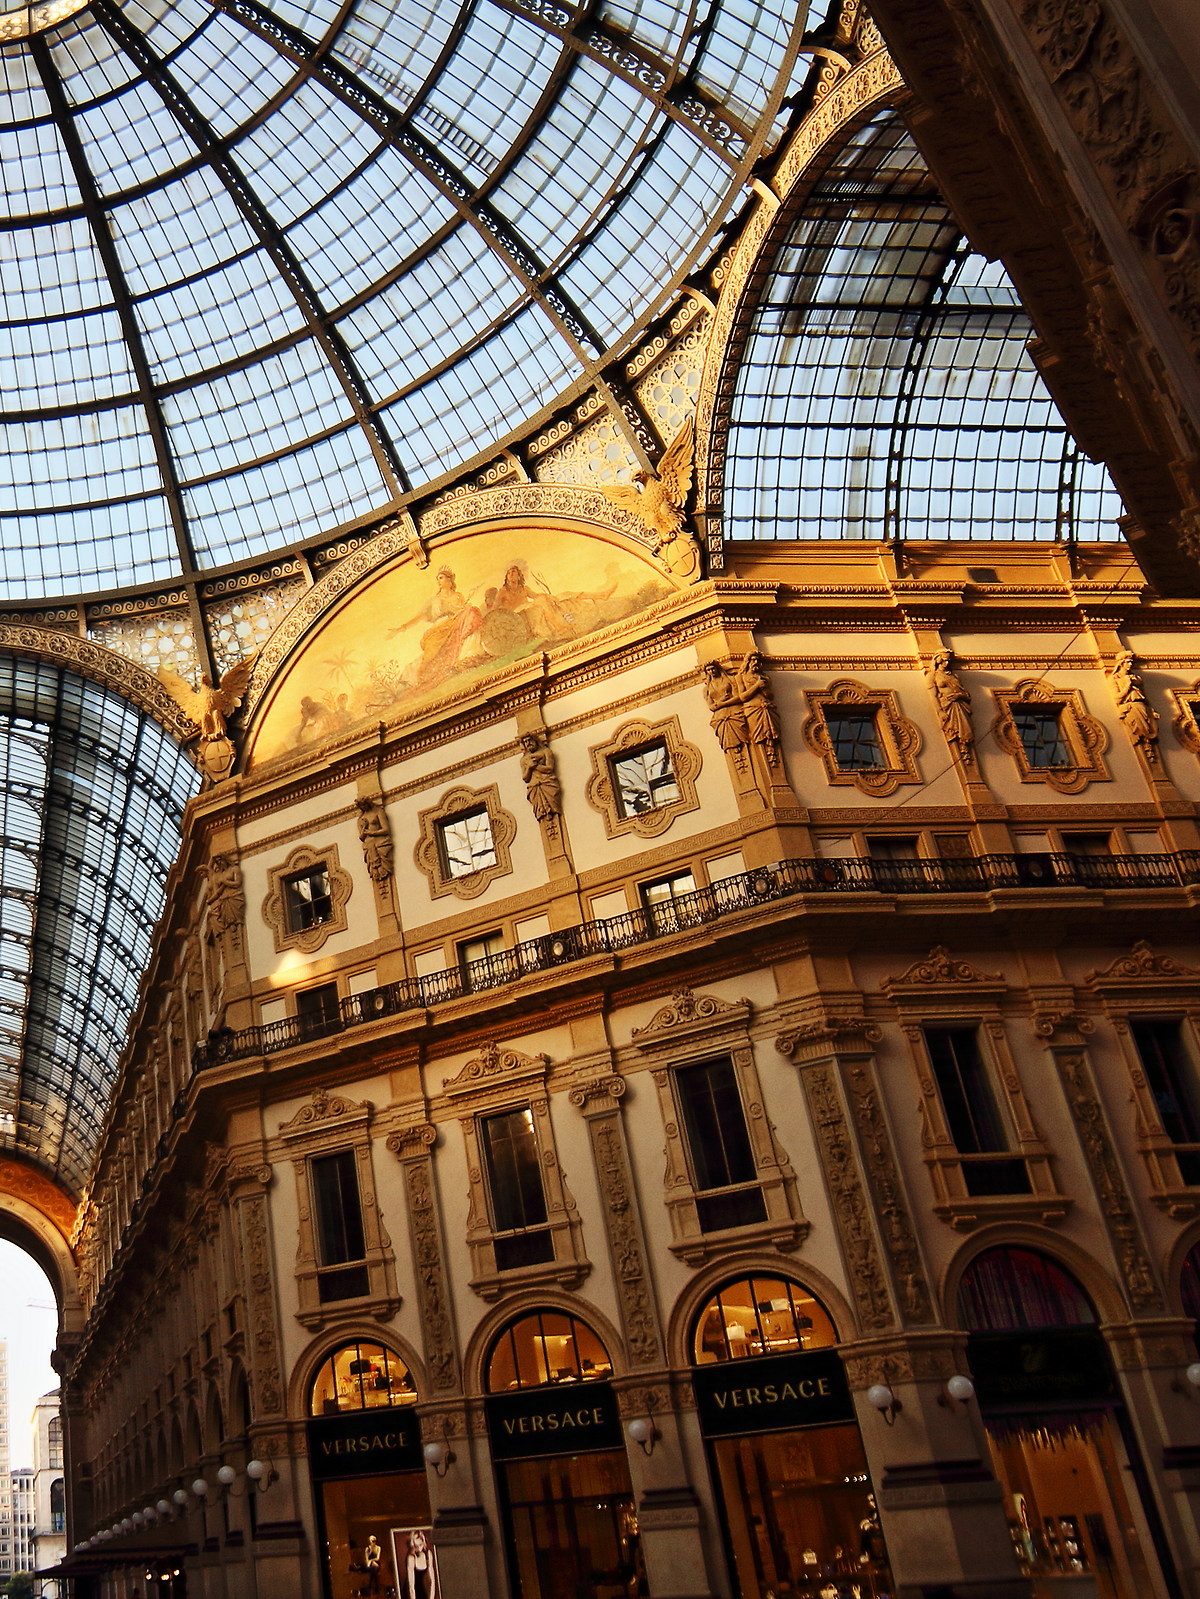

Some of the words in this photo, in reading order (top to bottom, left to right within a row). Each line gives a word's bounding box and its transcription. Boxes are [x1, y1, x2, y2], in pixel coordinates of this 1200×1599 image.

[711, 1377, 832, 1409] VERSACE
[502, 1406, 605, 1435] VERSACE
[320, 1431, 409, 1456] VERSACE
